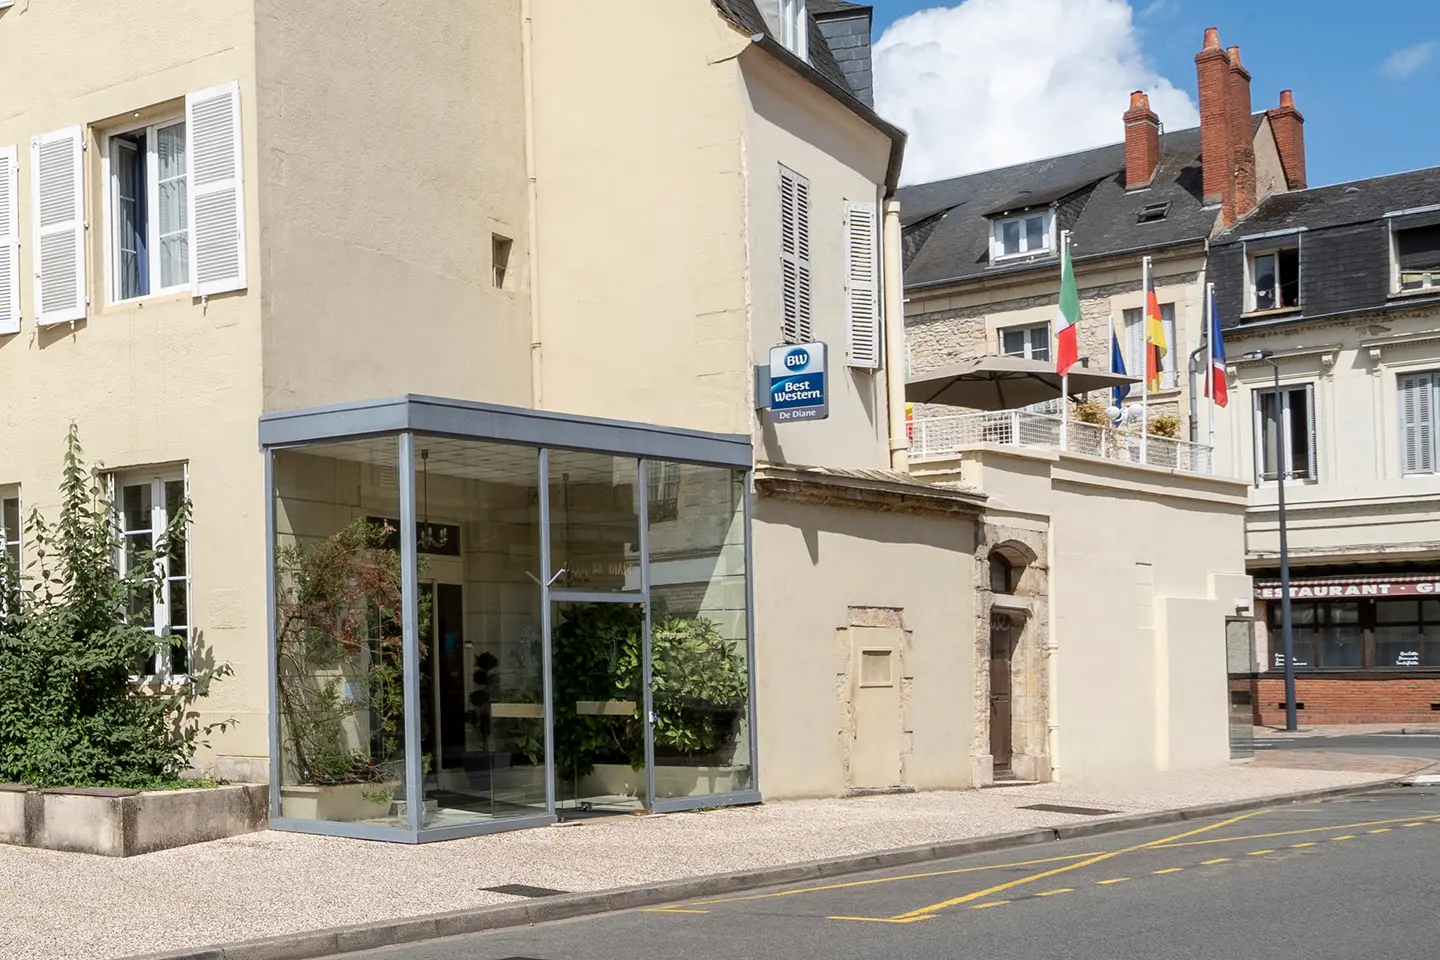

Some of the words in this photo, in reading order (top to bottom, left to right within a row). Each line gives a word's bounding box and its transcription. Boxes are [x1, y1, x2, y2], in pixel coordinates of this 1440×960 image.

[786, 354, 807, 367] BW
[785, 380, 810, 392] Best
[774, 390, 820, 402] Western
[779, 411, 791, 419] De
[792, 409, 816, 418] Diane
